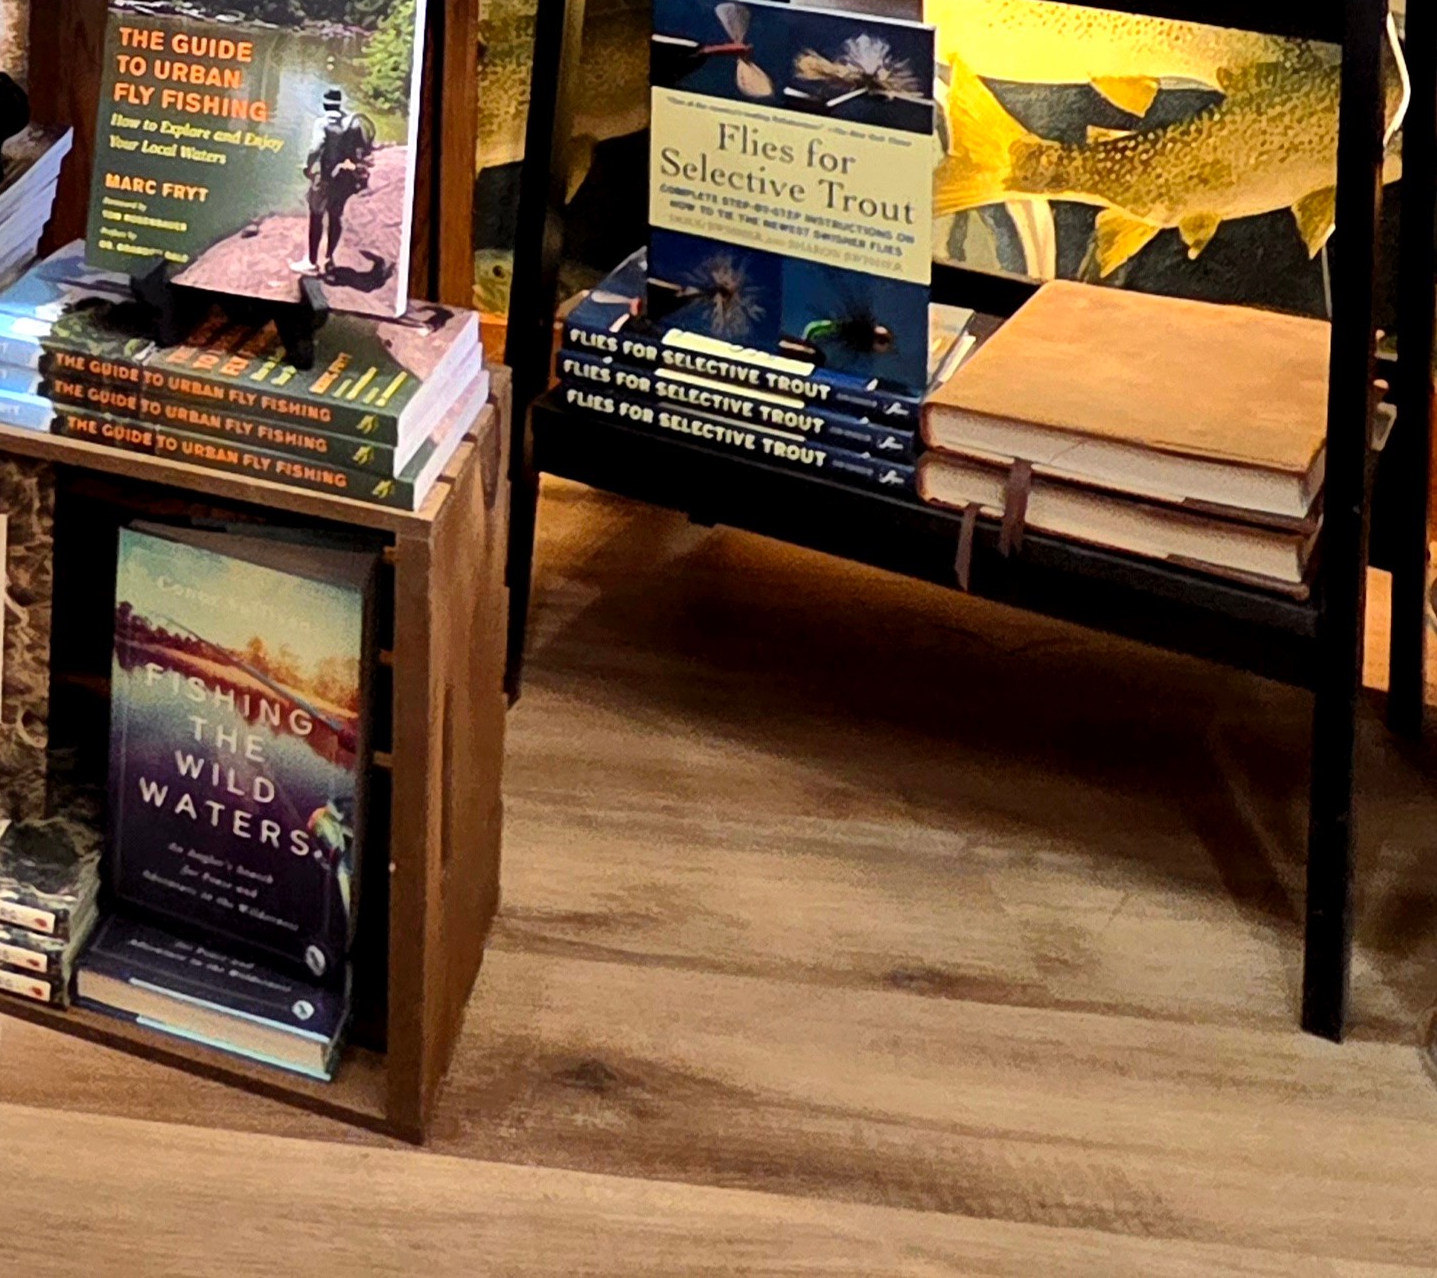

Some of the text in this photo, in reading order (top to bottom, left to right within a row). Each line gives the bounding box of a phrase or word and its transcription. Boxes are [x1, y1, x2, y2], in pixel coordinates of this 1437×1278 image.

[119, 26, 253, 62] THE GUIDE
[116, 54, 241, 90] TO URBAN
[113, 82, 270, 122] FLY FISHING
[109, 134, 227, 165] Your Local Waters
[110, 113, 285, 152] How to Explore and Enjoy
[718, 122, 856, 175] Flies for
[105, 173, 209, 203] MARC FRYT
[660, 147, 915, 225] Selective Trout
[55, 353, 331, 423] THE GUIDE TO URBAN FLY FISHING
[570, 329, 831, 400] FLIES FOR SELECTIVE TROUT
[144, 662, 314, 735] FISHING
[190, 715, 265, 764] THE
[175, 750, 276, 804] WILD
